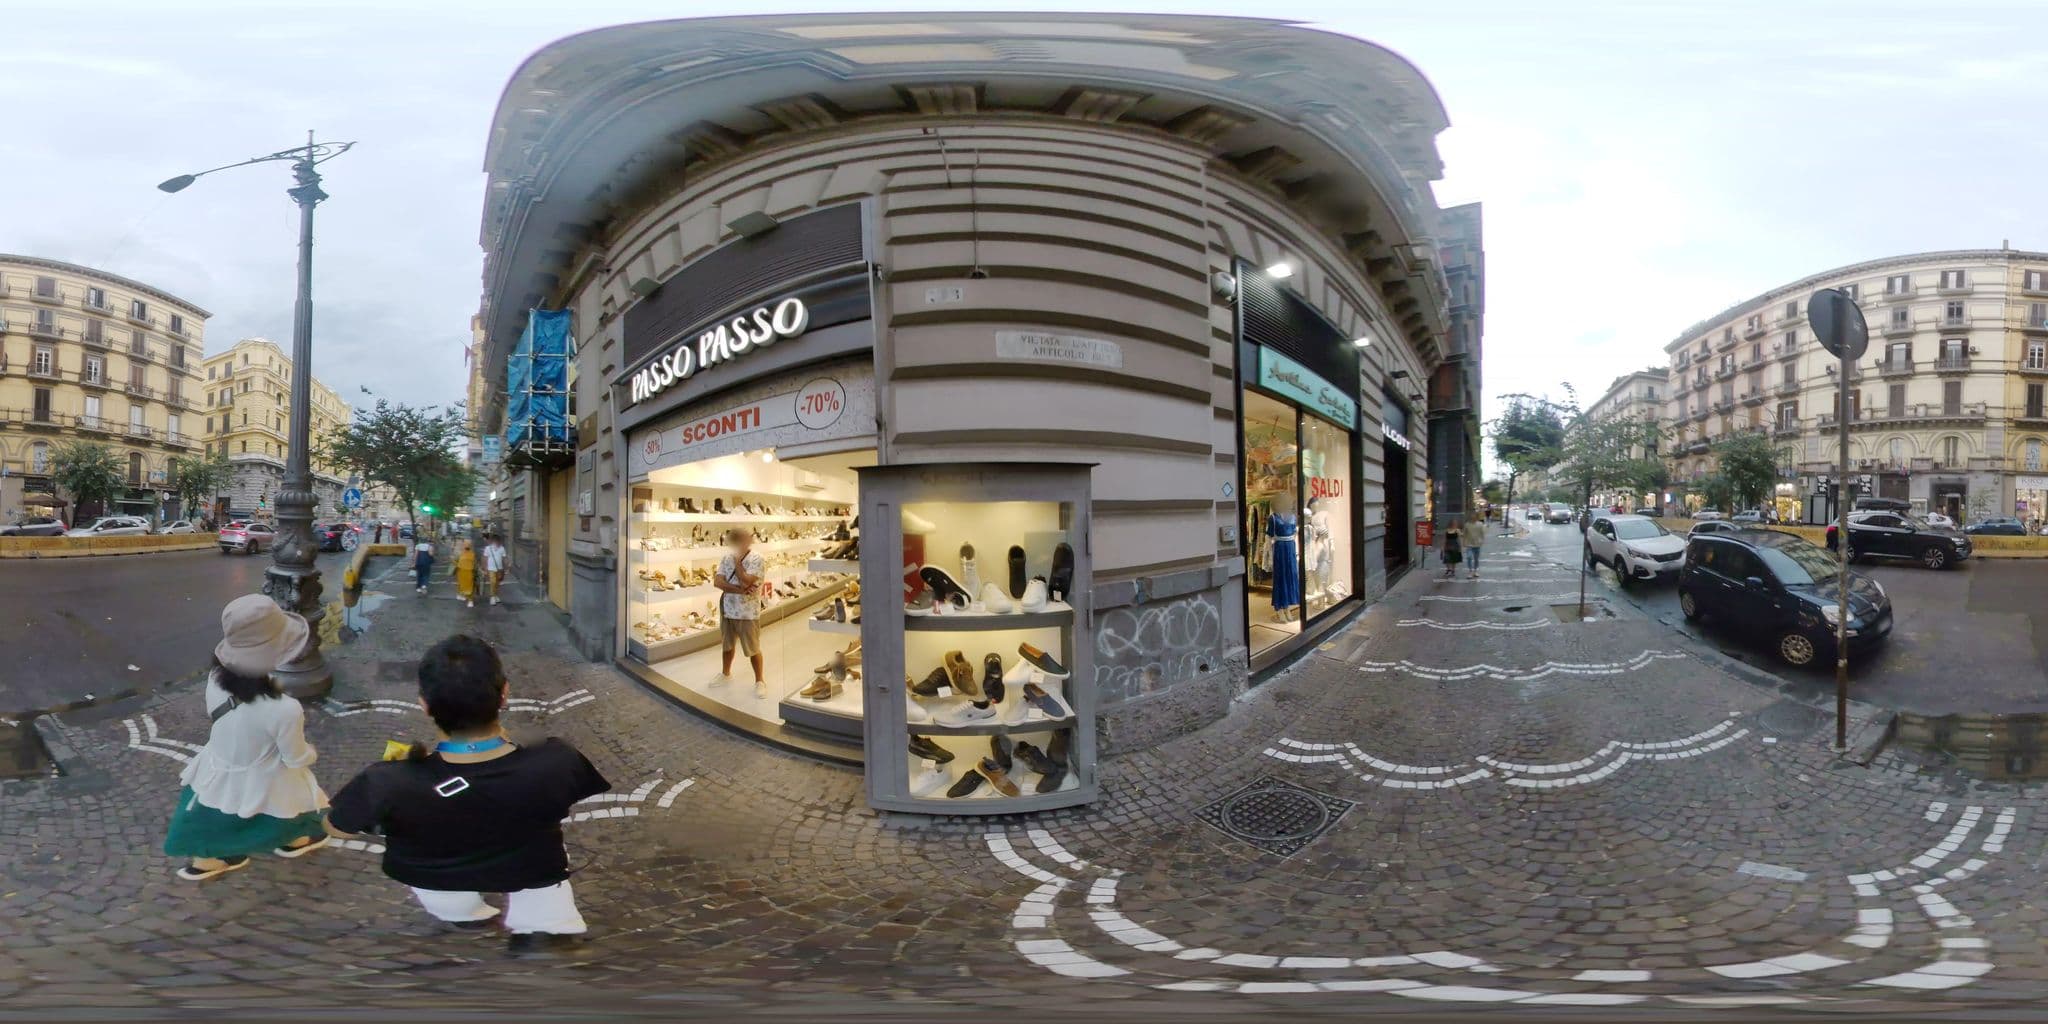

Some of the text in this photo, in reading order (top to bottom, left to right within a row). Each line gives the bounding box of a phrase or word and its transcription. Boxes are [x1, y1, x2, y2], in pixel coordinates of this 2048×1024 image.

[632, 298, 808, 403] PASSO PASSO
[800, 390, 839, 415] -70%
[682, 406, 760, 445] SCONTI
[645, 438, 661, 455] -50%
[1311, 476, 1344, 498] SALDI
